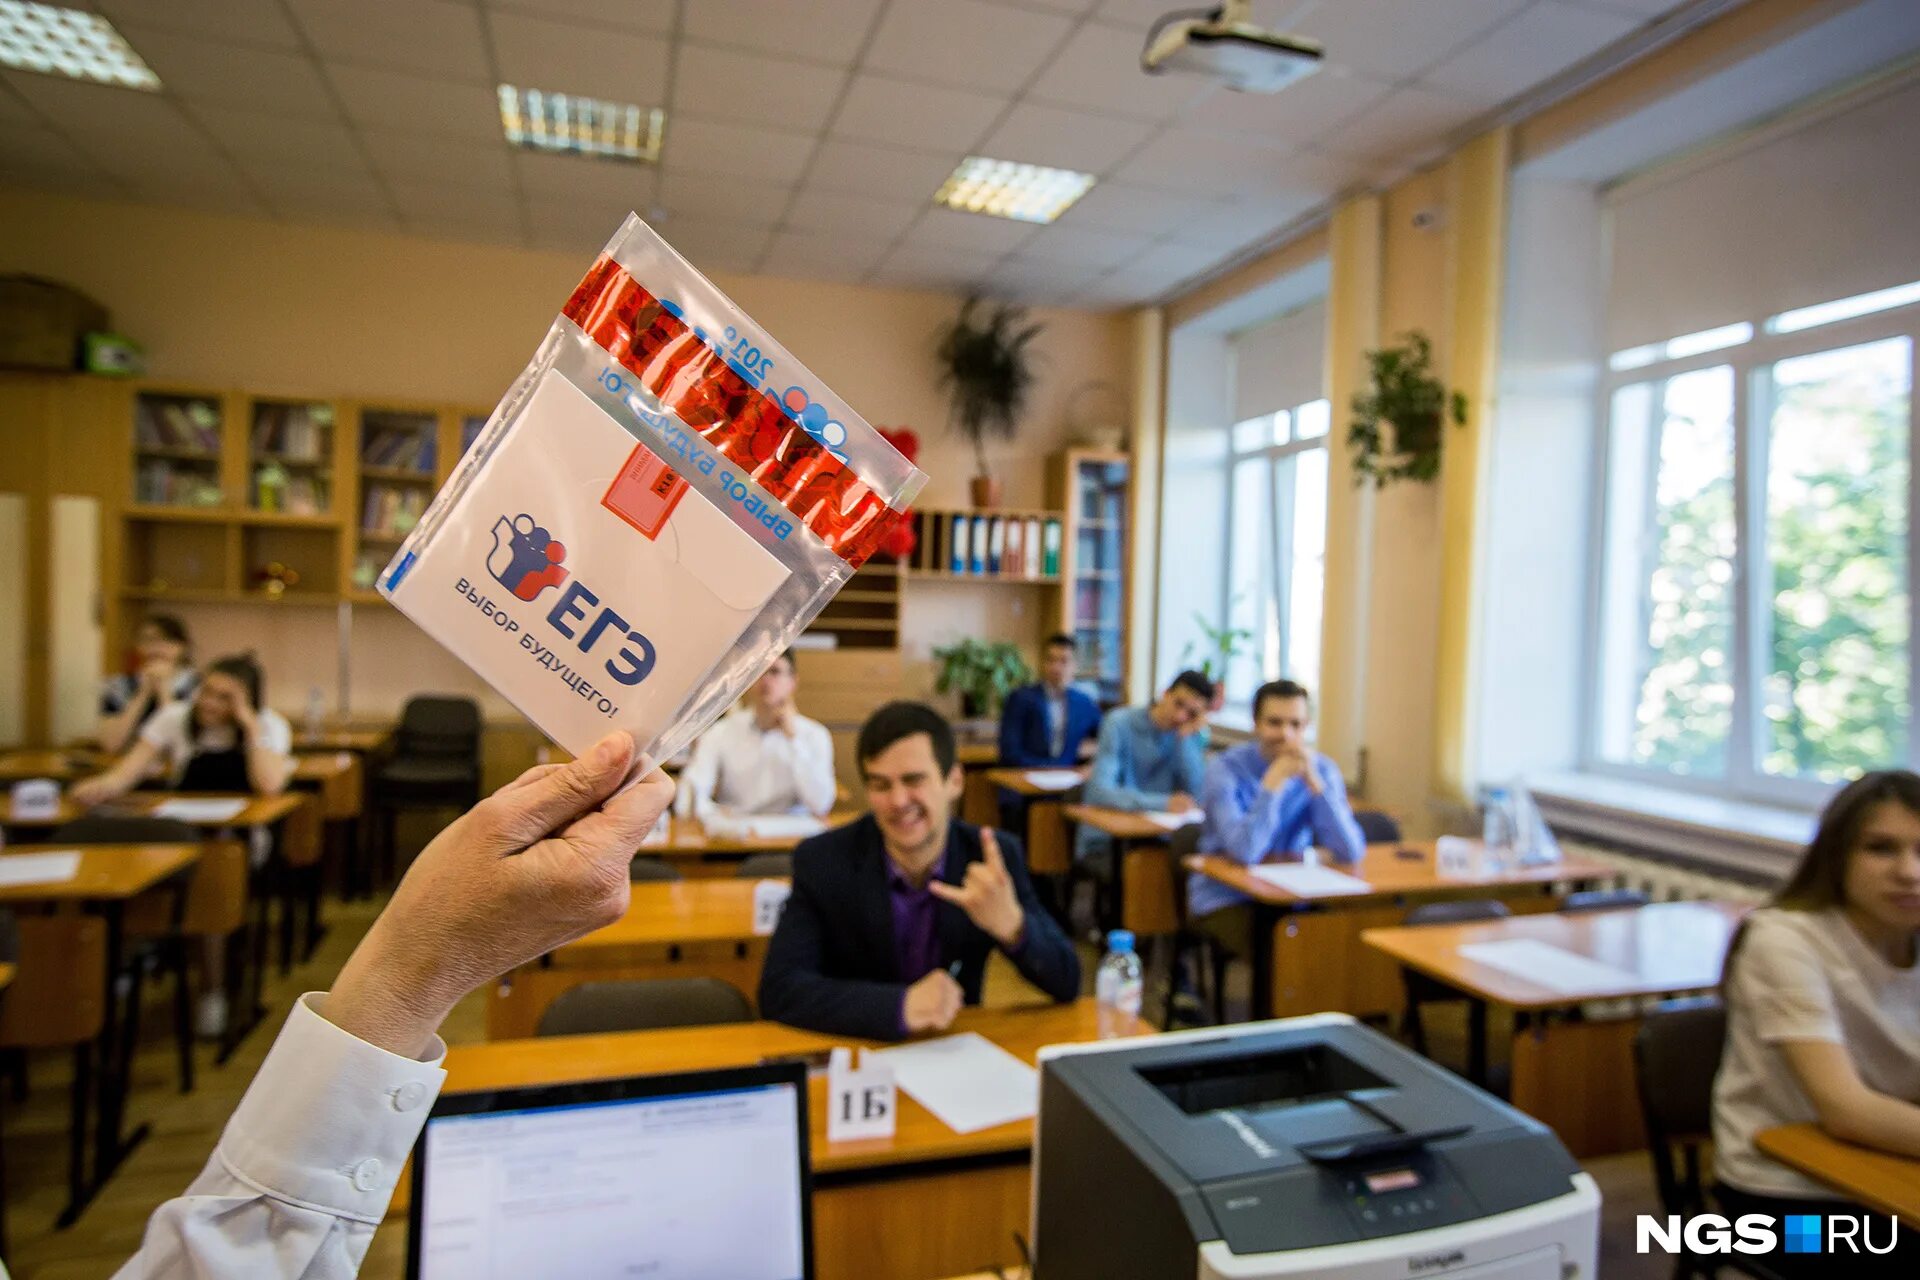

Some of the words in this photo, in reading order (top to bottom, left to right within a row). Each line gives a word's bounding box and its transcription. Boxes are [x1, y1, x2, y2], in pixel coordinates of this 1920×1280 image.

[455, 577, 520, 632] ВЫБОР
[519, 633, 619, 719] БУДУЩЕГО!
[546, 580, 657, 686] ЕГЭ
[841, 1085, 888, 1122] 1Б
